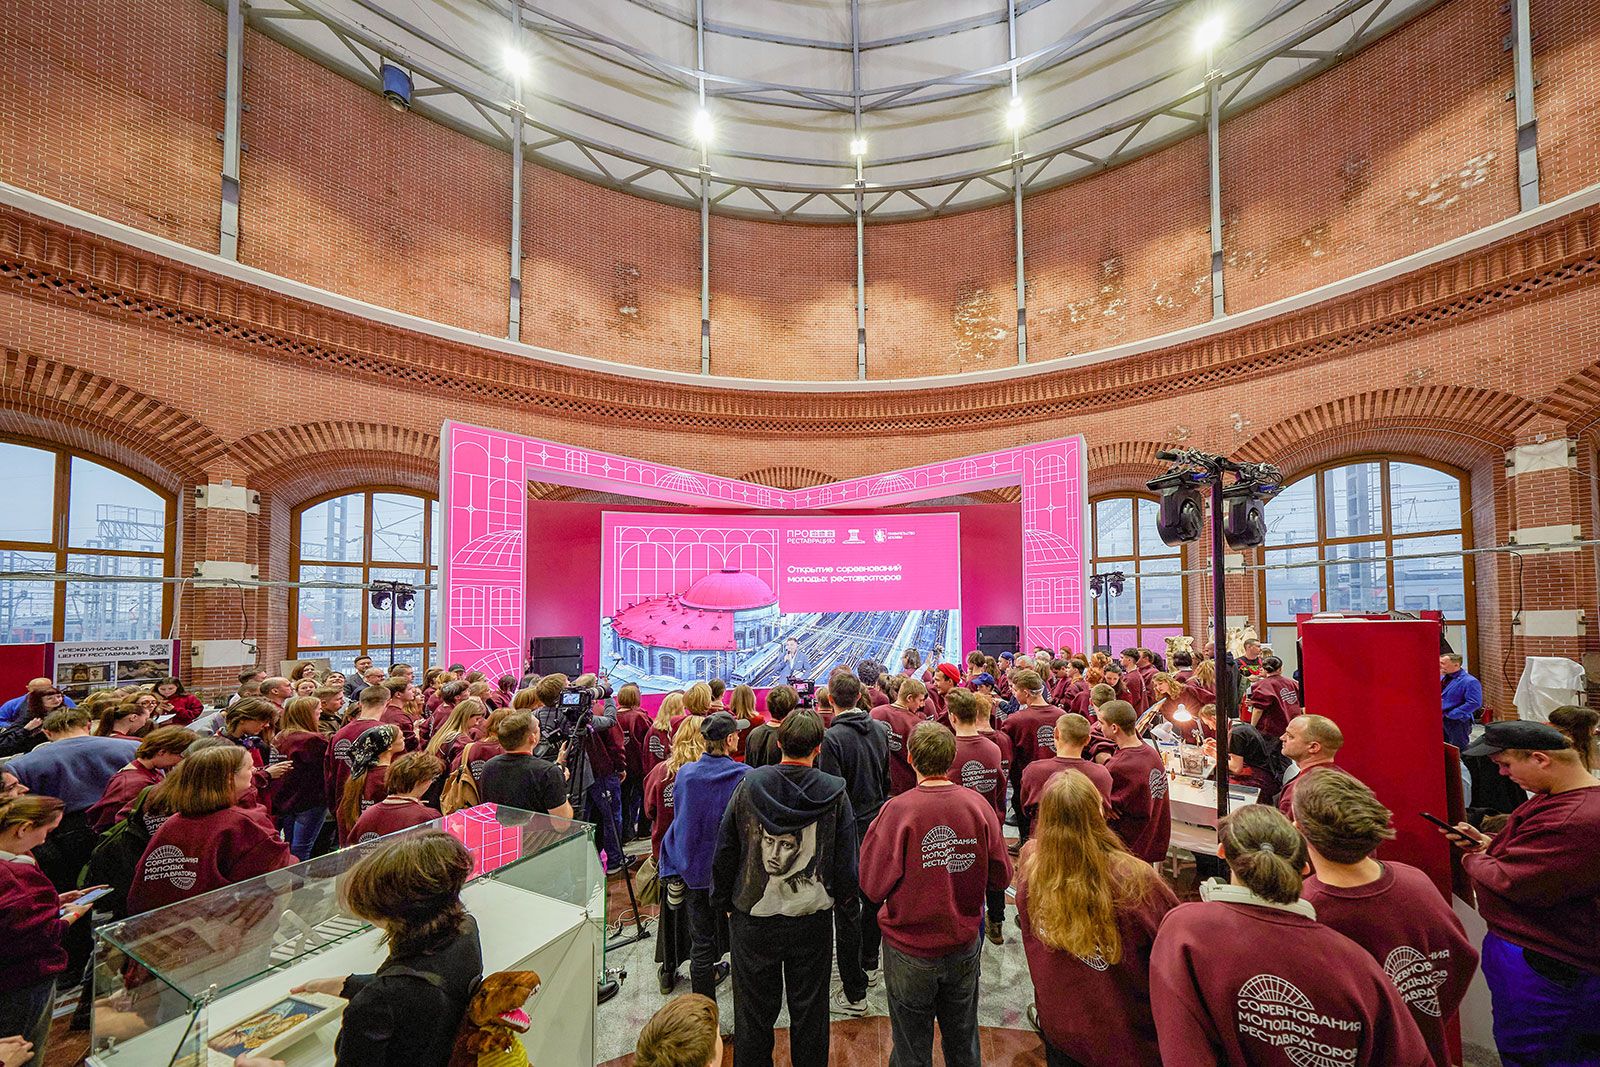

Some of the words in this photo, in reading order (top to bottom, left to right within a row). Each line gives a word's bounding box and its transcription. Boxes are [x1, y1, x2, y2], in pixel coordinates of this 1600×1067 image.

[786, 529, 809, 538] ПРО
[787, 565, 834, 575] Открытие
[836, 564, 902, 574] соревнований
[830, 574, 902, 583] реставраторов
[1237, 999, 1361, 1032] СОРЕВНОВАНИЯ
[1238, 1011, 1316, 1038] МОЛОДЫХ
